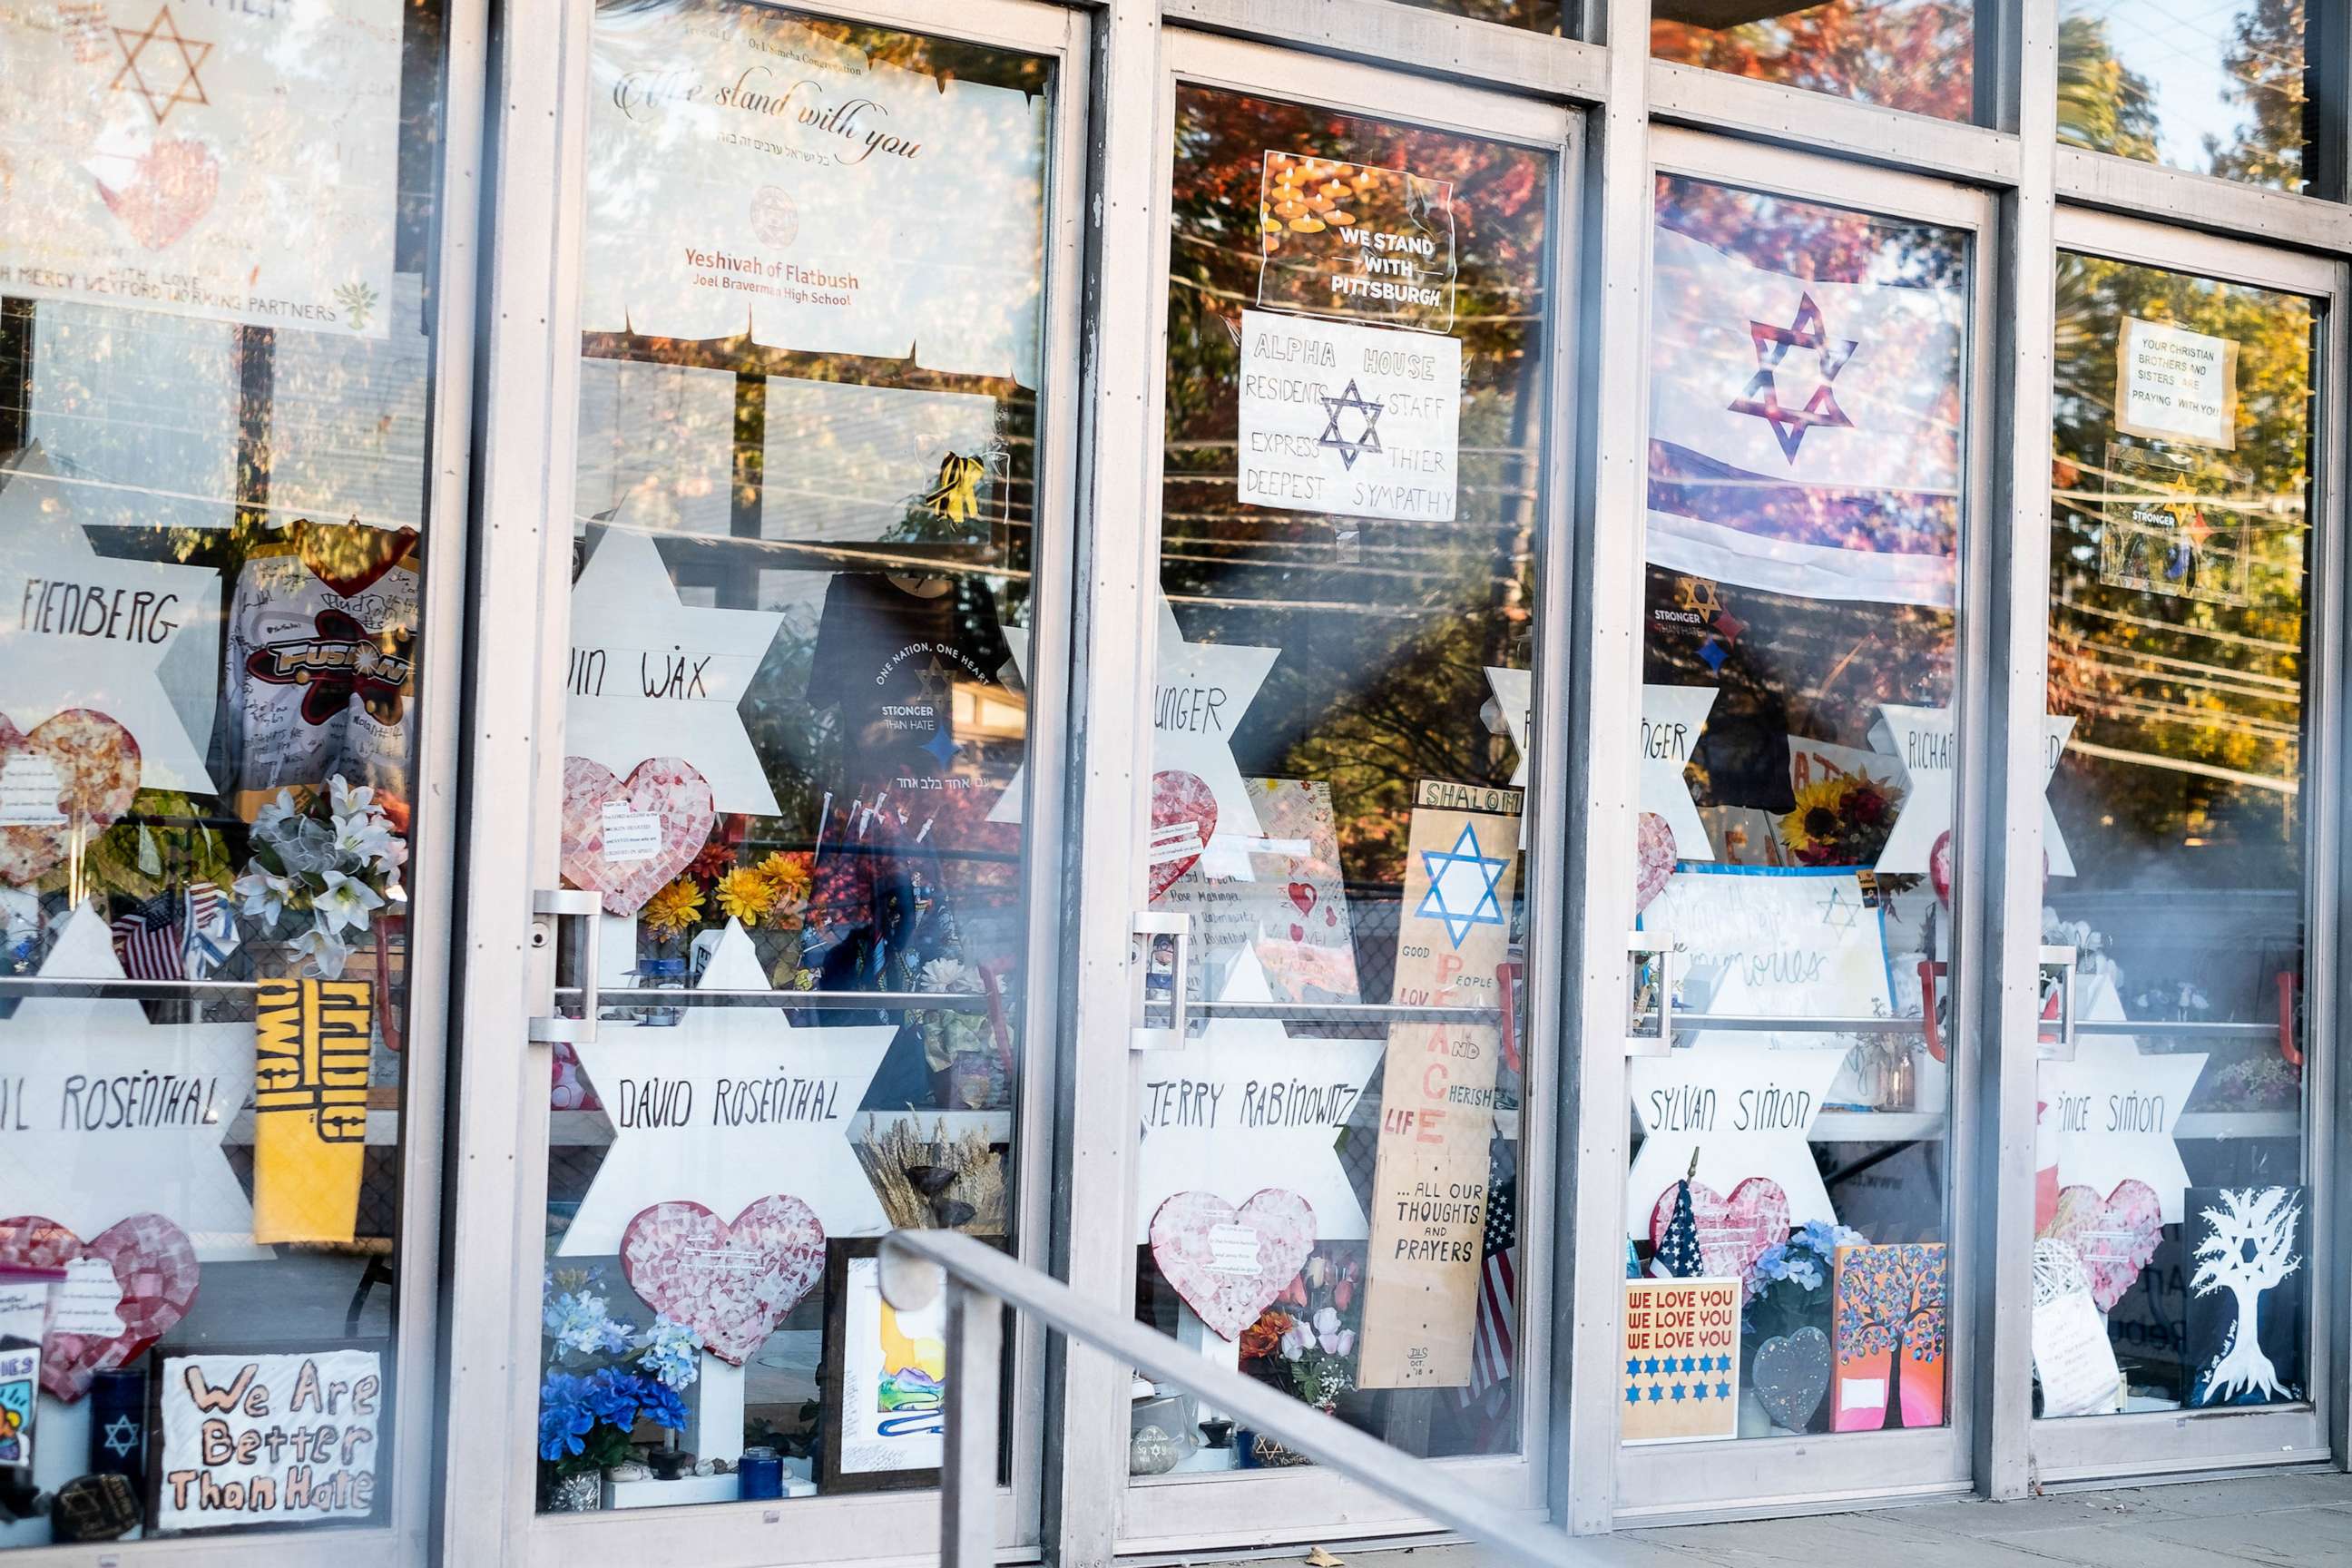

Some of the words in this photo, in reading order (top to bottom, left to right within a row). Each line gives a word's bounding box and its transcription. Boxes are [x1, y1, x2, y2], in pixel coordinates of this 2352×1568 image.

[801, 53, 862, 75] Congregation
[715, 65, 822, 116] stand
[798, 98, 887, 138] with
[834, 129, 923, 165] you
[1339, 227, 1371, 247] WE
[1373, 232, 1436, 257] STAND
[685, 248, 762, 275] Yeshivah
[767, 261, 782, 278] of
[786, 265, 859, 290] Flatbush
[1364, 256, 1414, 278] WITH
[693, 274, 719, 288] Joel
[722, 277, 782, 298] Braverman
[784, 288, 808, 304] High
[811, 292, 852, 306] School
[1331, 275, 1441, 307] PITTSBURGH
[249, 297, 337, 322] PARTNERS
[1253, 333, 1337, 368] ALPHA
[1363, 348, 1436, 380] HOUSE
[2139, 354, 2188, 372] BROTHERS
[2190, 363, 2206, 376] AND
[2141, 338, 2167, 352] YOUR
[2169, 344, 2214, 361] CHRISTIAN
[2138, 369, 2174, 386] SISTERS
[2182, 378, 2200, 391] ARE
[1246, 374, 1330, 406] RESIDENTS
[1389, 393, 1446, 421] STAFF
[2132, 389, 2171, 407] PRAYING
[2178, 398, 2199, 412] WITH
[2200, 405, 2220, 417] YOU
[1250, 431, 1320, 458] EXPRESS
[1387, 446, 1446, 473] THIER
[1247, 469, 1325, 500] DEEPEST
[1353, 483, 1454, 515] SYMPATHY
[2132, 511, 2175, 527] STRONGER
[21, 579, 179, 644] FIENBERG
[1654, 610, 1700, 623] STRONGER
[568, 647, 606, 697] IN
[642, 651, 711, 700] WAX
[877, 662, 894, 686] ONE
[936, 642, 959, 659] ONE
[961, 655, 990, 686] HEART
[882, 706, 934, 717] STRONGER
[884, 719, 908, 730] THAN
[910, 720, 936, 730] HATE
[1154, 685, 1227, 734] UNGER
[1641, 723, 1688, 761] NGER
[920, 776, 943, 790] בלב
[946, 778, 971, 790] אחד
[1426, 782, 1521, 814] SHALOM
[1402, 946, 1430, 959] GOOD
[62, 1074, 219, 1131] ROSENTHAL
[620, 1079, 692, 1129] DAVID
[713, 1077, 838, 1127] ROSENTHAL
[1144, 1081, 1225, 1129] JERRY
[1240, 1080, 1358, 1128] RABINOWITZ
[1449, 1085, 1493, 1107] HERISH
[1651, 1087, 1716, 1132] SYLVAN
[1733, 1088, 1810, 1131] SIMON
[2106, 1094, 2164, 1132] SIMON
[1415, 1182, 1440, 1198] ALL
[1449, 1183, 1483, 1200] OUR
[1396, 1201, 1480, 1224] THOUGHTS
[1425, 1227, 1447, 1237] AND
[1395, 1239, 1474, 1262] PRAYERS
[1629, 1292, 1651, 1308] WE
[1656, 1291, 1696, 1308] LOVE
[1700, 1290, 1733, 1307] YOU
[1628, 1312, 1651, 1328] WE
[1655, 1311, 1695, 1328] LOVE
[1700, 1310, 1732, 1327] YOU
[1627, 1332, 1650, 1349] WE
[1655, 1331, 1694, 1348] LOVE
[1699, 1330, 1731, 1347] YOU
[184, 1363, 270, 1417] We
[289, 1358, 379, 1416] Are
[201, 1418, 373, 1466] Better
[168, 1468, 277, 1513] Than
[284, 1464, 375, 1513] Hate
